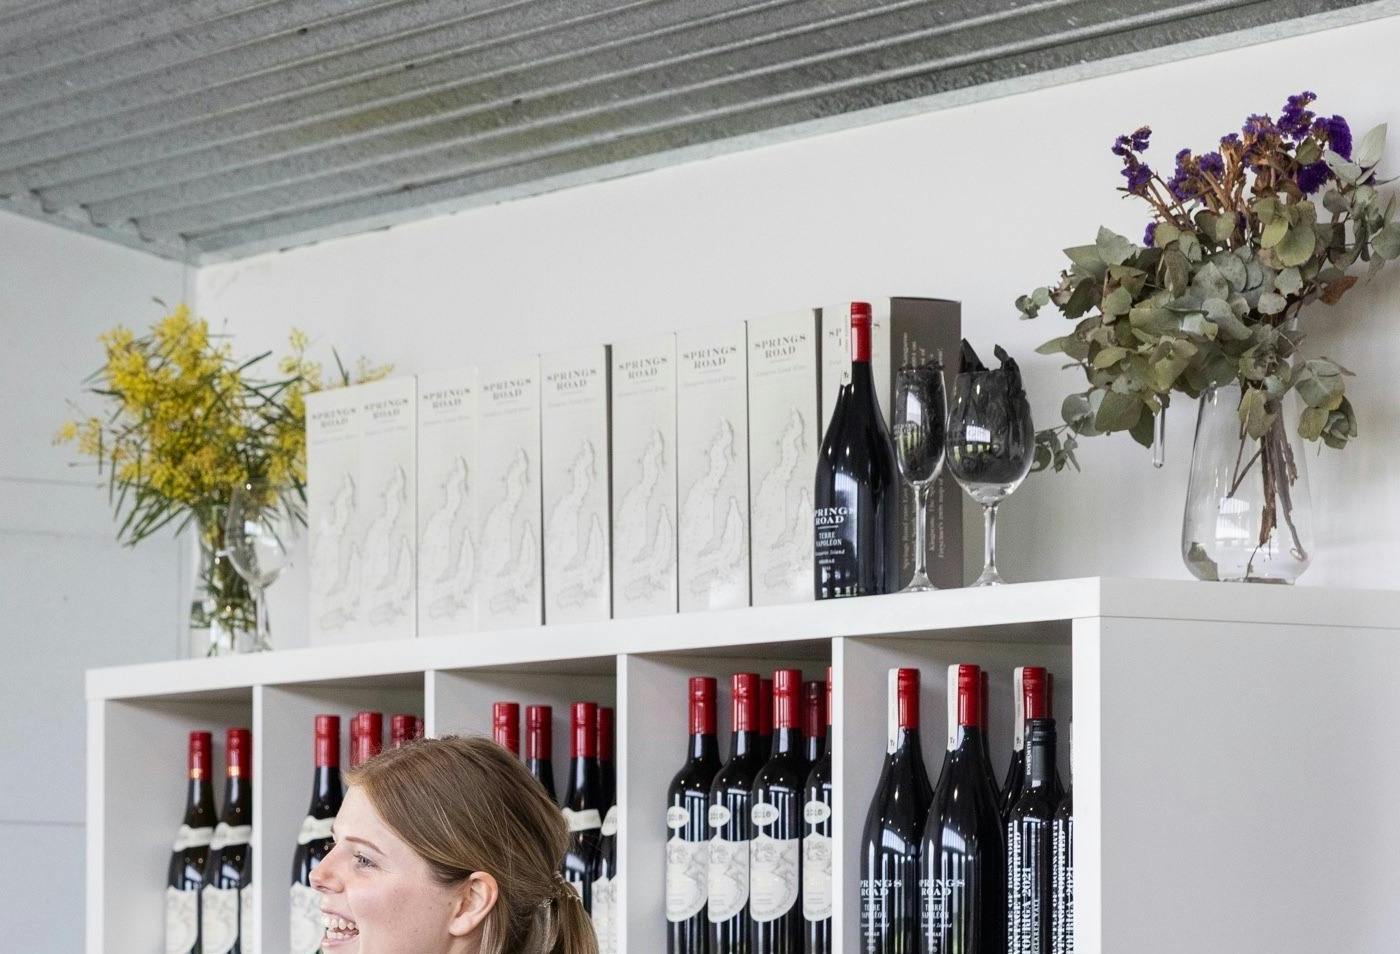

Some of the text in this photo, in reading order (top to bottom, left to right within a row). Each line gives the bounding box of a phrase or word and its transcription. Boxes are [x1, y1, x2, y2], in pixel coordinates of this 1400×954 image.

[754, 334, 807, 349] SPRINGS
[683, 344, 737, 360] SPRINGS
[765, 346, 797, 359] ROAD
[618, 357, 668, 370] SPRINGS
[694, 357, 727, 369] ROAD
[547, 368, 597, 381] SPRINGS
[628, 368, 657, 379] ROAD
[483, 378, 531, 392] SPRINGS
[557, 379, 587, 390] ROAD
[423, 387, 471, 401] SPRINGS
[493, 388, 522, 400] ROAD
[433, 398, 461, 409] ROAD
[815, 506, 855, 517] PRING
[815, 515, 844, 525] ROAD
[860, 879, 902, 888] PRINGS
[919, 879, 965, 888] PRINGS
[1022, 867, 1030, 898] 2021
[861, 888, 889, 896] ROAD
[921, 888, 952, 896] ROAD
